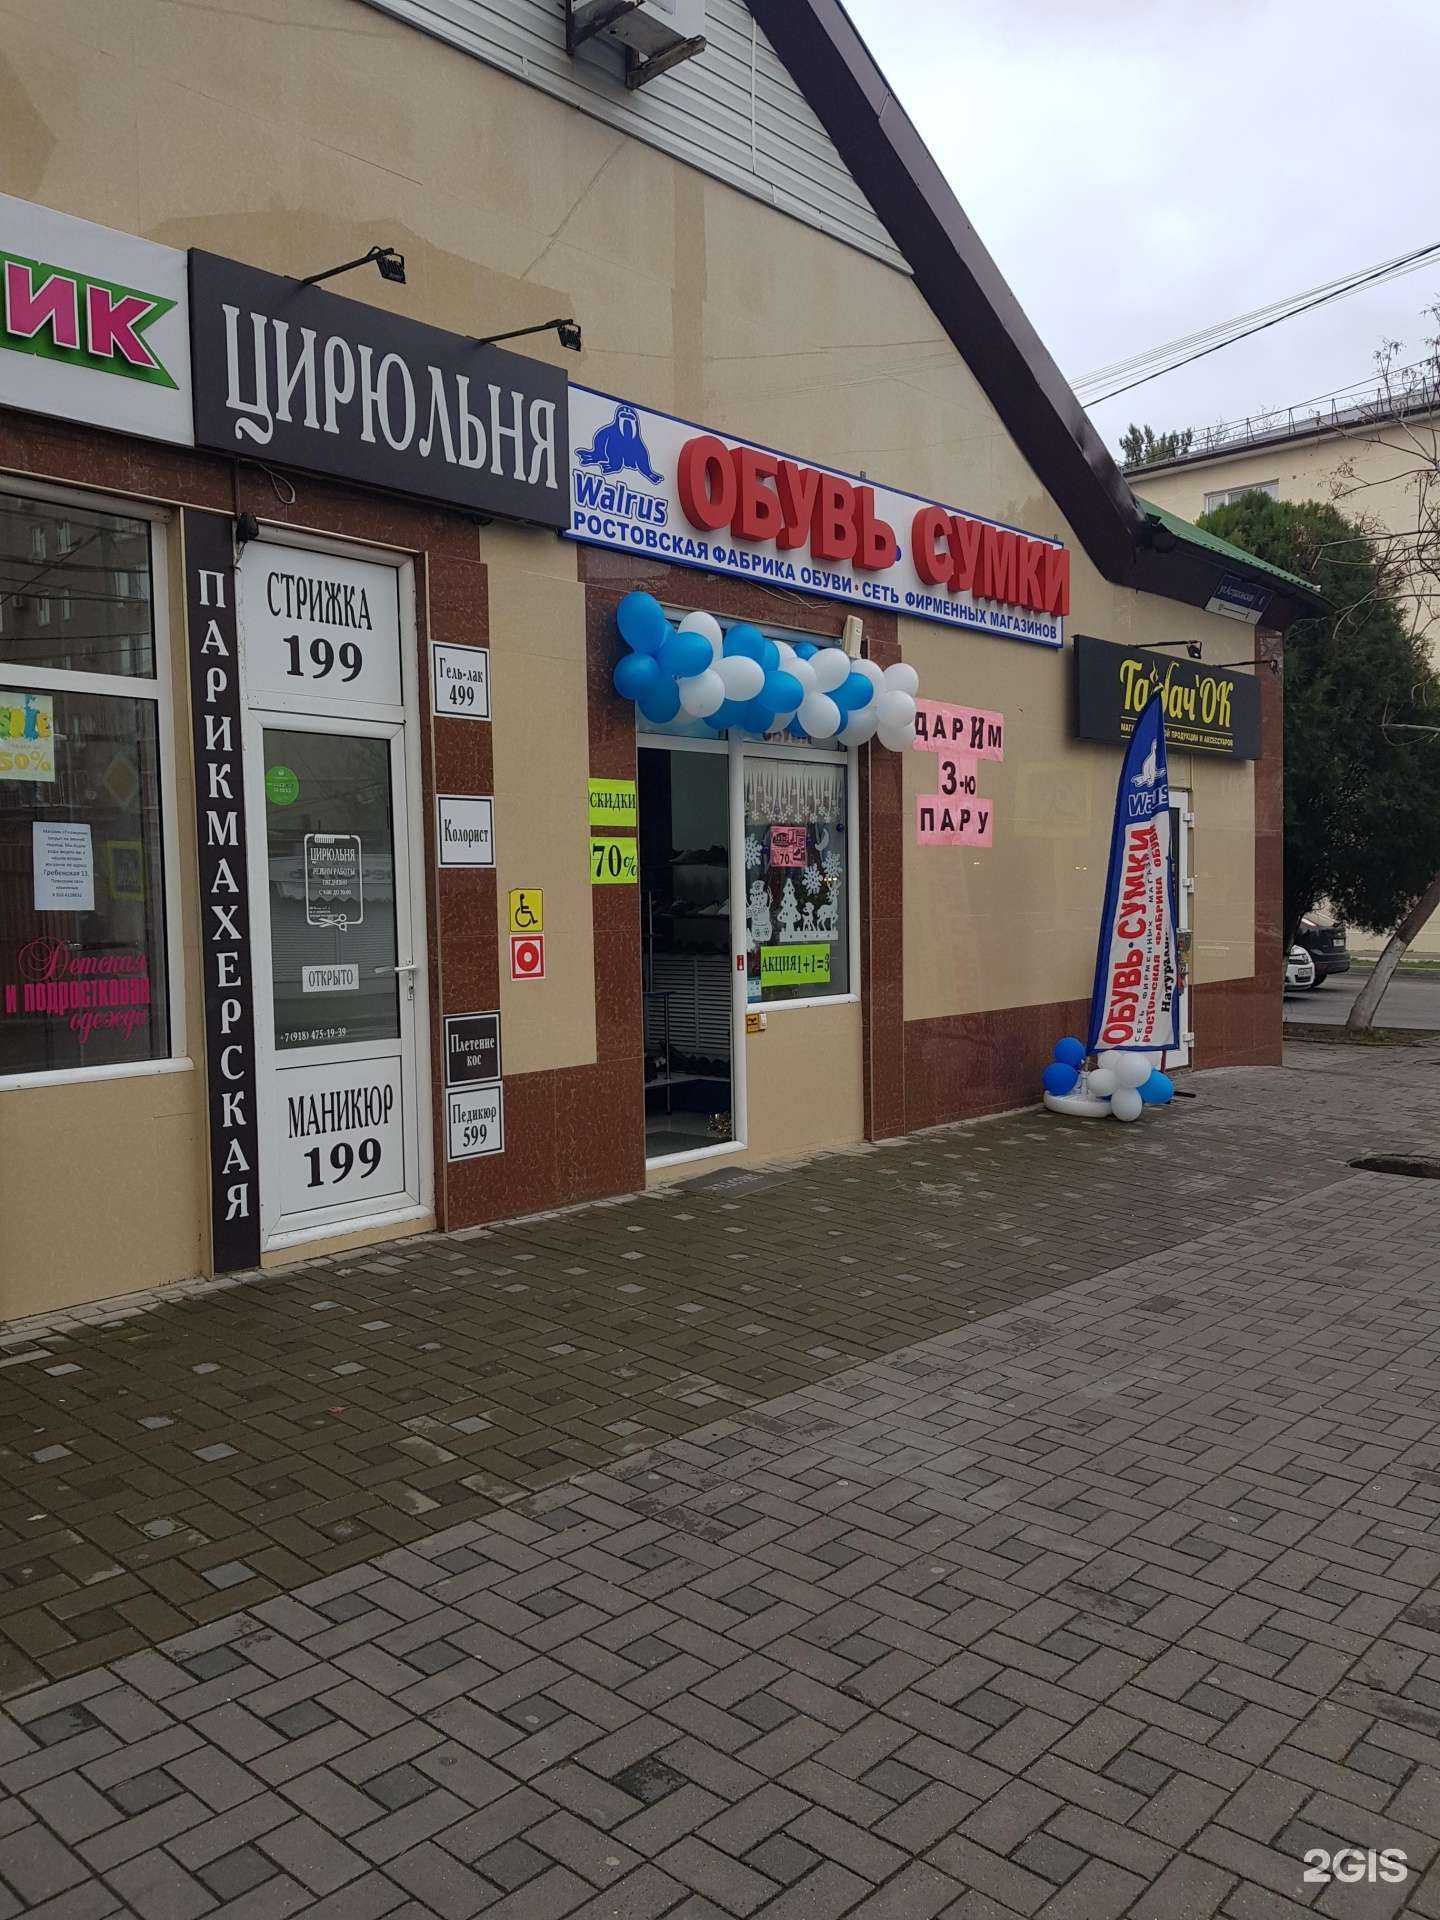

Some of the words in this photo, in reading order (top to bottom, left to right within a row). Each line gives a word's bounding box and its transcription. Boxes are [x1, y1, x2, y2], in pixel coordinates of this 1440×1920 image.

[222, 304, 559, 489] ЦИРЮЛЬНЯ
[573, 469, 668, 526] Walrus
[677, 435, 898, 572] ОБУВЬ
[911, 506, 1070, 616] СУМКИ
[573, 511, 708, 560] РОСТОВСКАЯ
[712, 546, 796, 581] ФАБРИКА
[800, 566, 852, 593] ОБУВИ
[862, 582, 900, 605] СЕТЬ
[905, 591, 987, 626] ФИРМЕННЫХ
[990, 612, 1057, 640] МАГАЗИНОВ
[266, 571, 373, 631] СТРИЖКА
[283, 634, 364, 683] 199
[439, 657, 483, 683] Гель-лак
[449, 684, 475, 707] 499
[914, 712, 1002, 750] ДАРИМ
[590, 791, 636, 813] СКИДКИ
[920, 808, 989, 834] ПАРУ
[444, 818, 489, 848] Колорист
[310, 847, 356, 865] ЦИРЮЛЬНЯ
[592, 843, 637, 877] 70%
[198, 569, 251, 1221] ПАРИКМАХЕРСКАЯ
[1117, 828, 1153, 939] СУМКИ
[1154, 876, 1164, 946] ФАБРИКА
[308, 969, 354, 988] ОТКРЫТО
[1102, 949, 1144, 1044] ОБУВЬ
[450, 1033, 495, 1053] Плетение
[466, 1054, 482, 1067] кос
[288, 1084, 393, 1139] МАНИКЮР
[452, 1103, 497, 1125] Педикюр
[463, 1124, 487, 1148] 599
[304, 1138, 382, 1188] 199
